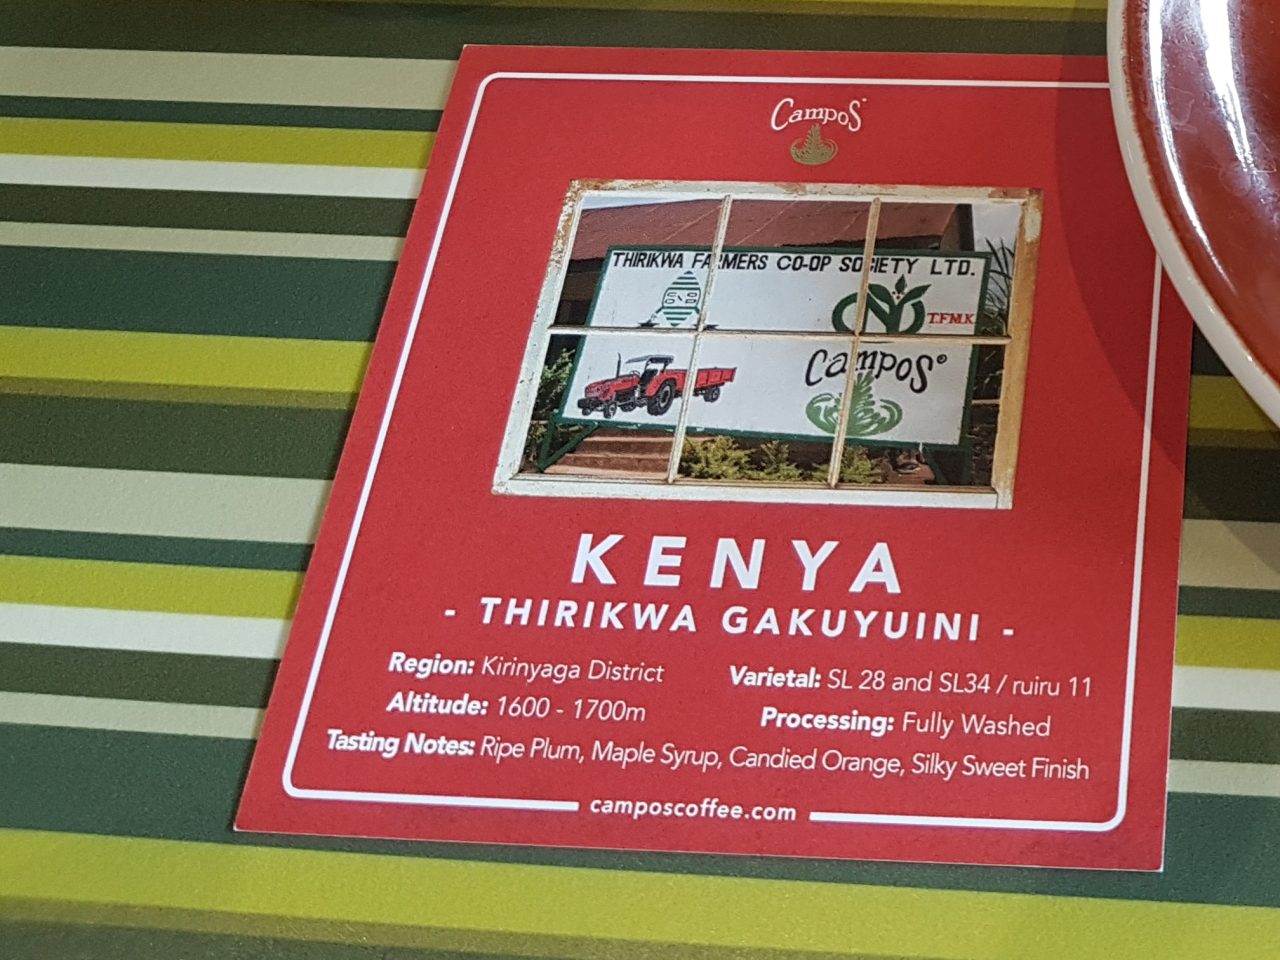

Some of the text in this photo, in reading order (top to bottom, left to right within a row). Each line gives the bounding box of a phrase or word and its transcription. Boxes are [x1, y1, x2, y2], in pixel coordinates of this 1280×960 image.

[612, 251, 684, 269] THIRIKWA
[691, 252, 768, 270] FAMERS
[776, 255, 832, 272] CO-OP
[929, 258, 976, 276] LTD.
[570, 533, 902, 594] KENYA
[480, 596, 697, 633] THIRIKWA
[721, 605, 980, 642] GAKUYUINI
[388, 651, 665, 685] Region: Kirinyaga District
[729, 664, 1091, 697] Varietal: SL 28 and SL34 / ruiru 11
[386, 690, 489, 716] Altitude:
[498, 695, 551, 718] 1600
[574, 698, 646, 722] 1700m
[760, 706, 1052, 740] Processing: Fully Washed
[327, 728, 1090, 782] Tasting Notes: Ripe Plum, Maple Syrup, Candied Orange, Silky Sweet Finish
[589, 797, 797, 824] camposcoffee.com
